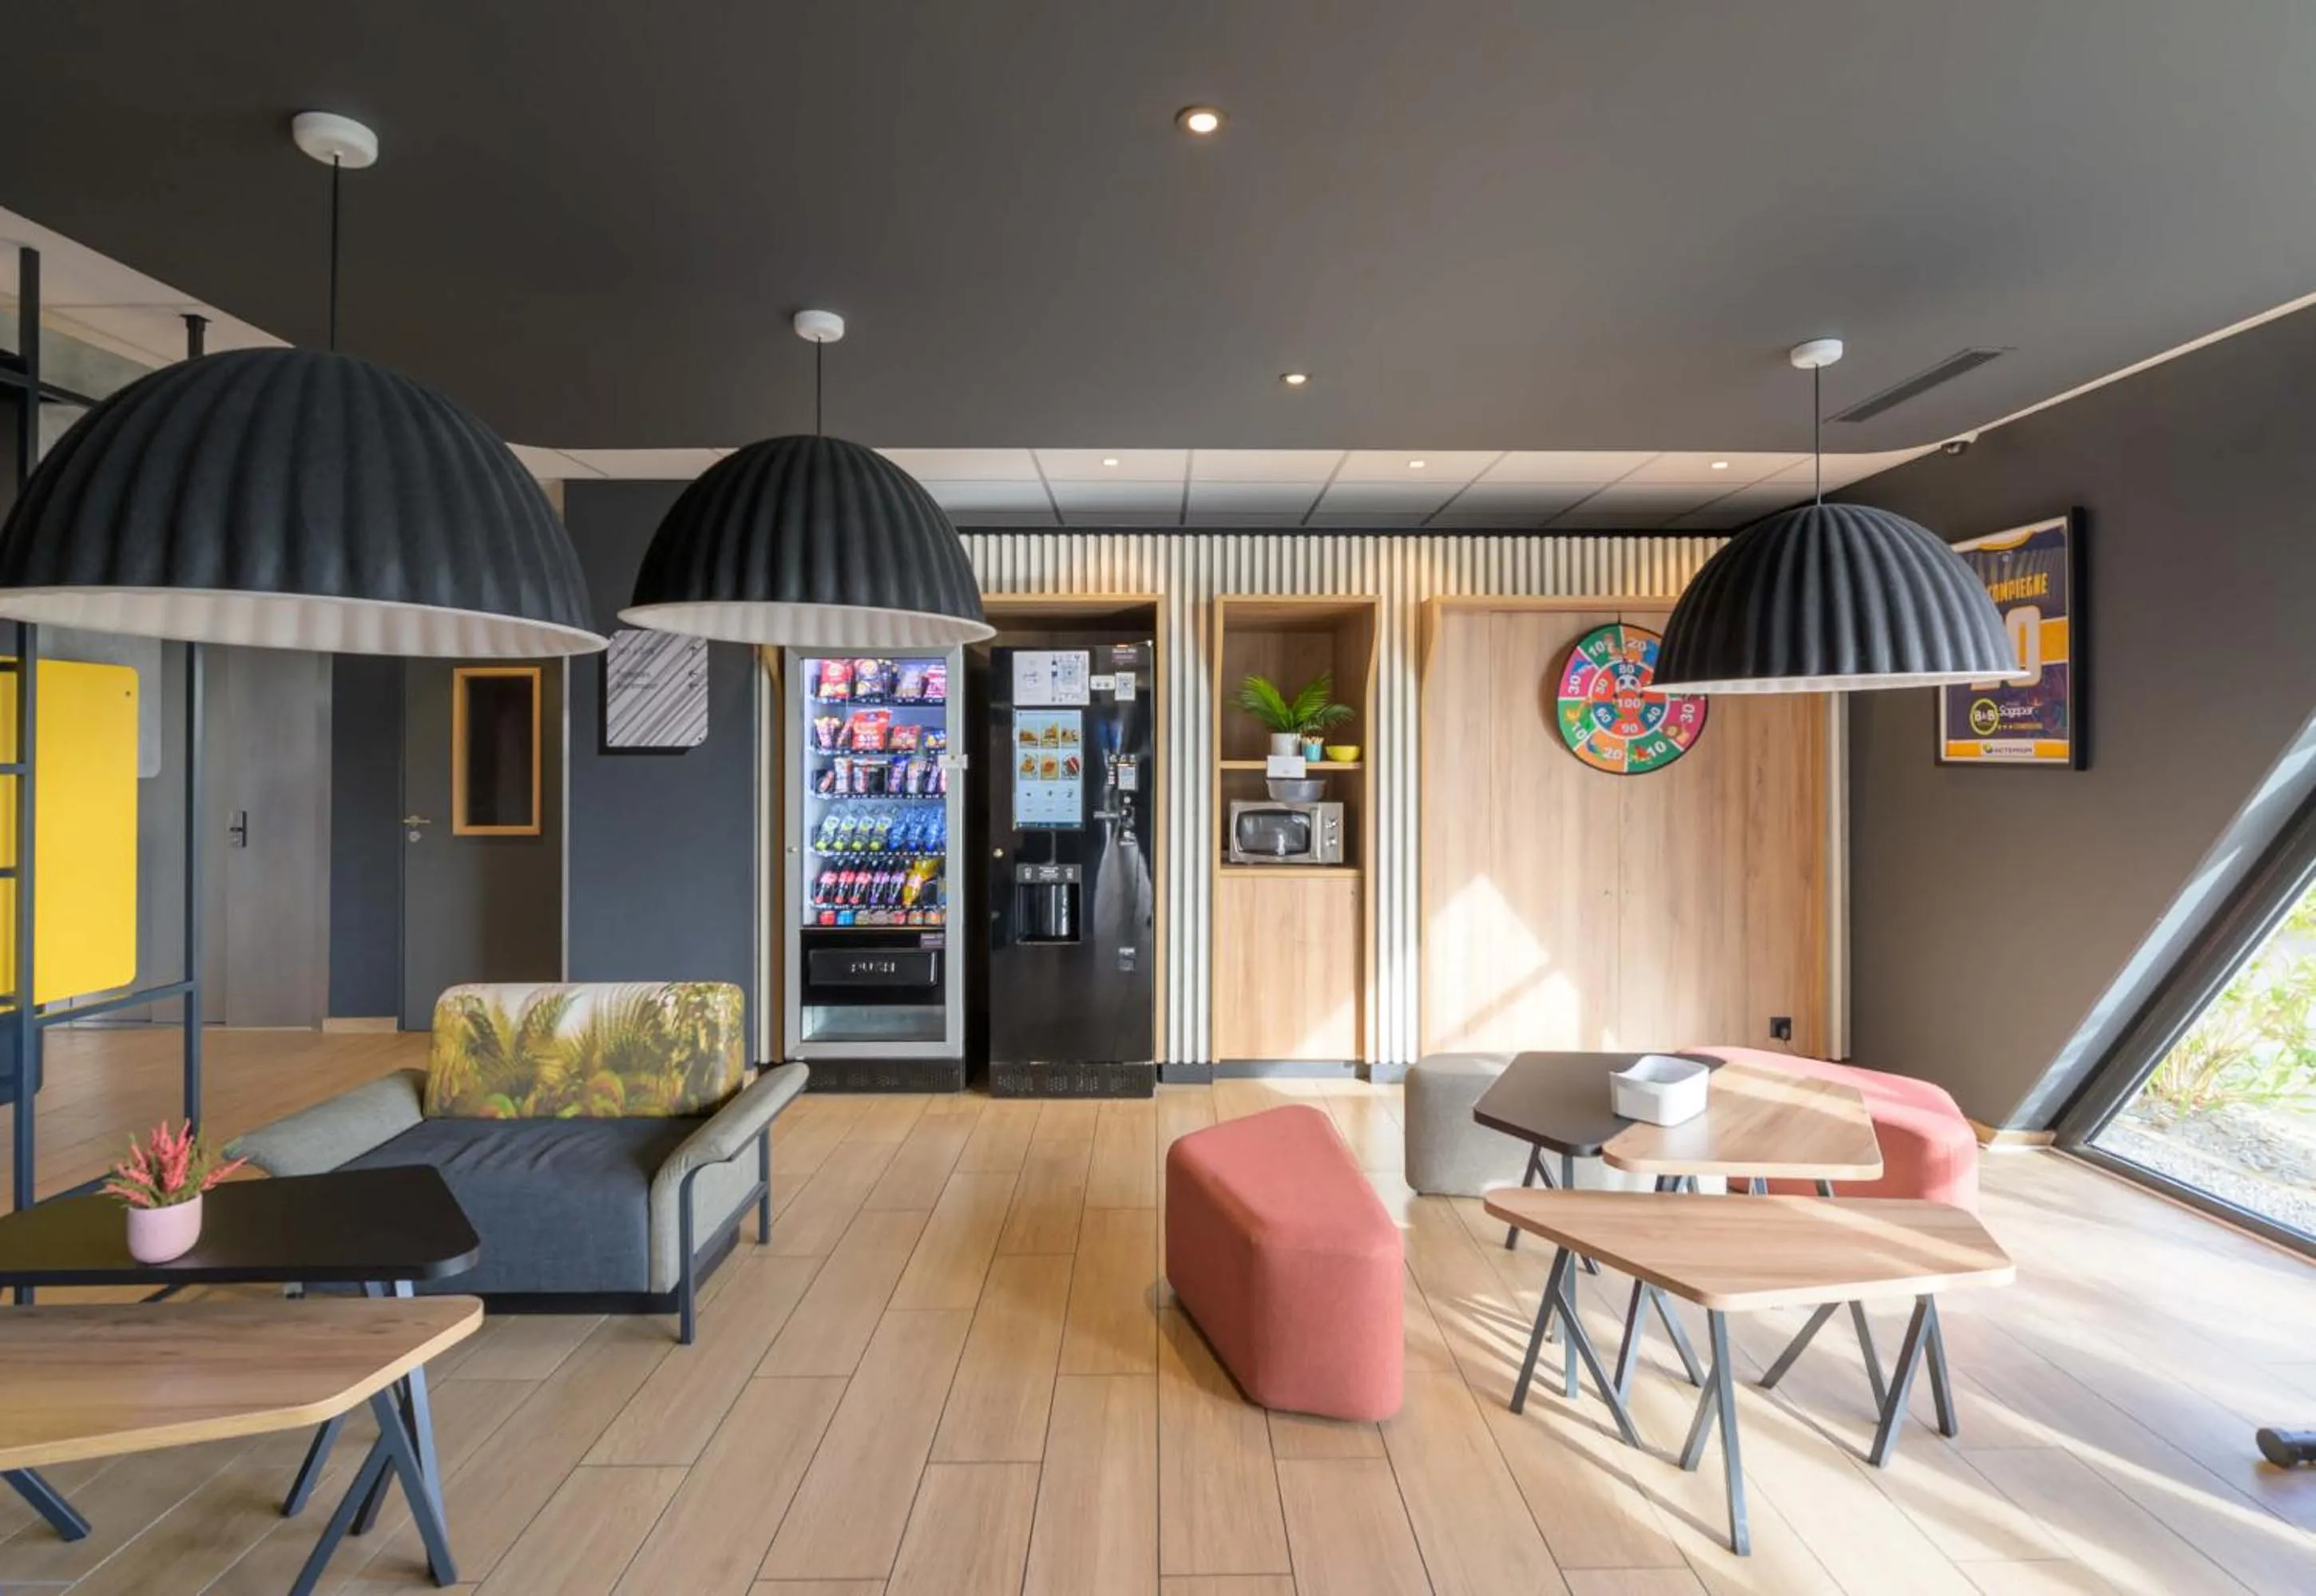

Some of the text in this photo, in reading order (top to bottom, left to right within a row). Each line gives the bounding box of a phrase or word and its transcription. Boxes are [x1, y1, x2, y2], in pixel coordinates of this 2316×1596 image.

[1589, 641, 1606, 657] 10
[1568, 675, 1580, 695] 30
[1618, 698, 1640, 708] 100
[1679, 703, 1695, 723] 30
[1646, 741, 1667, 757] 10
